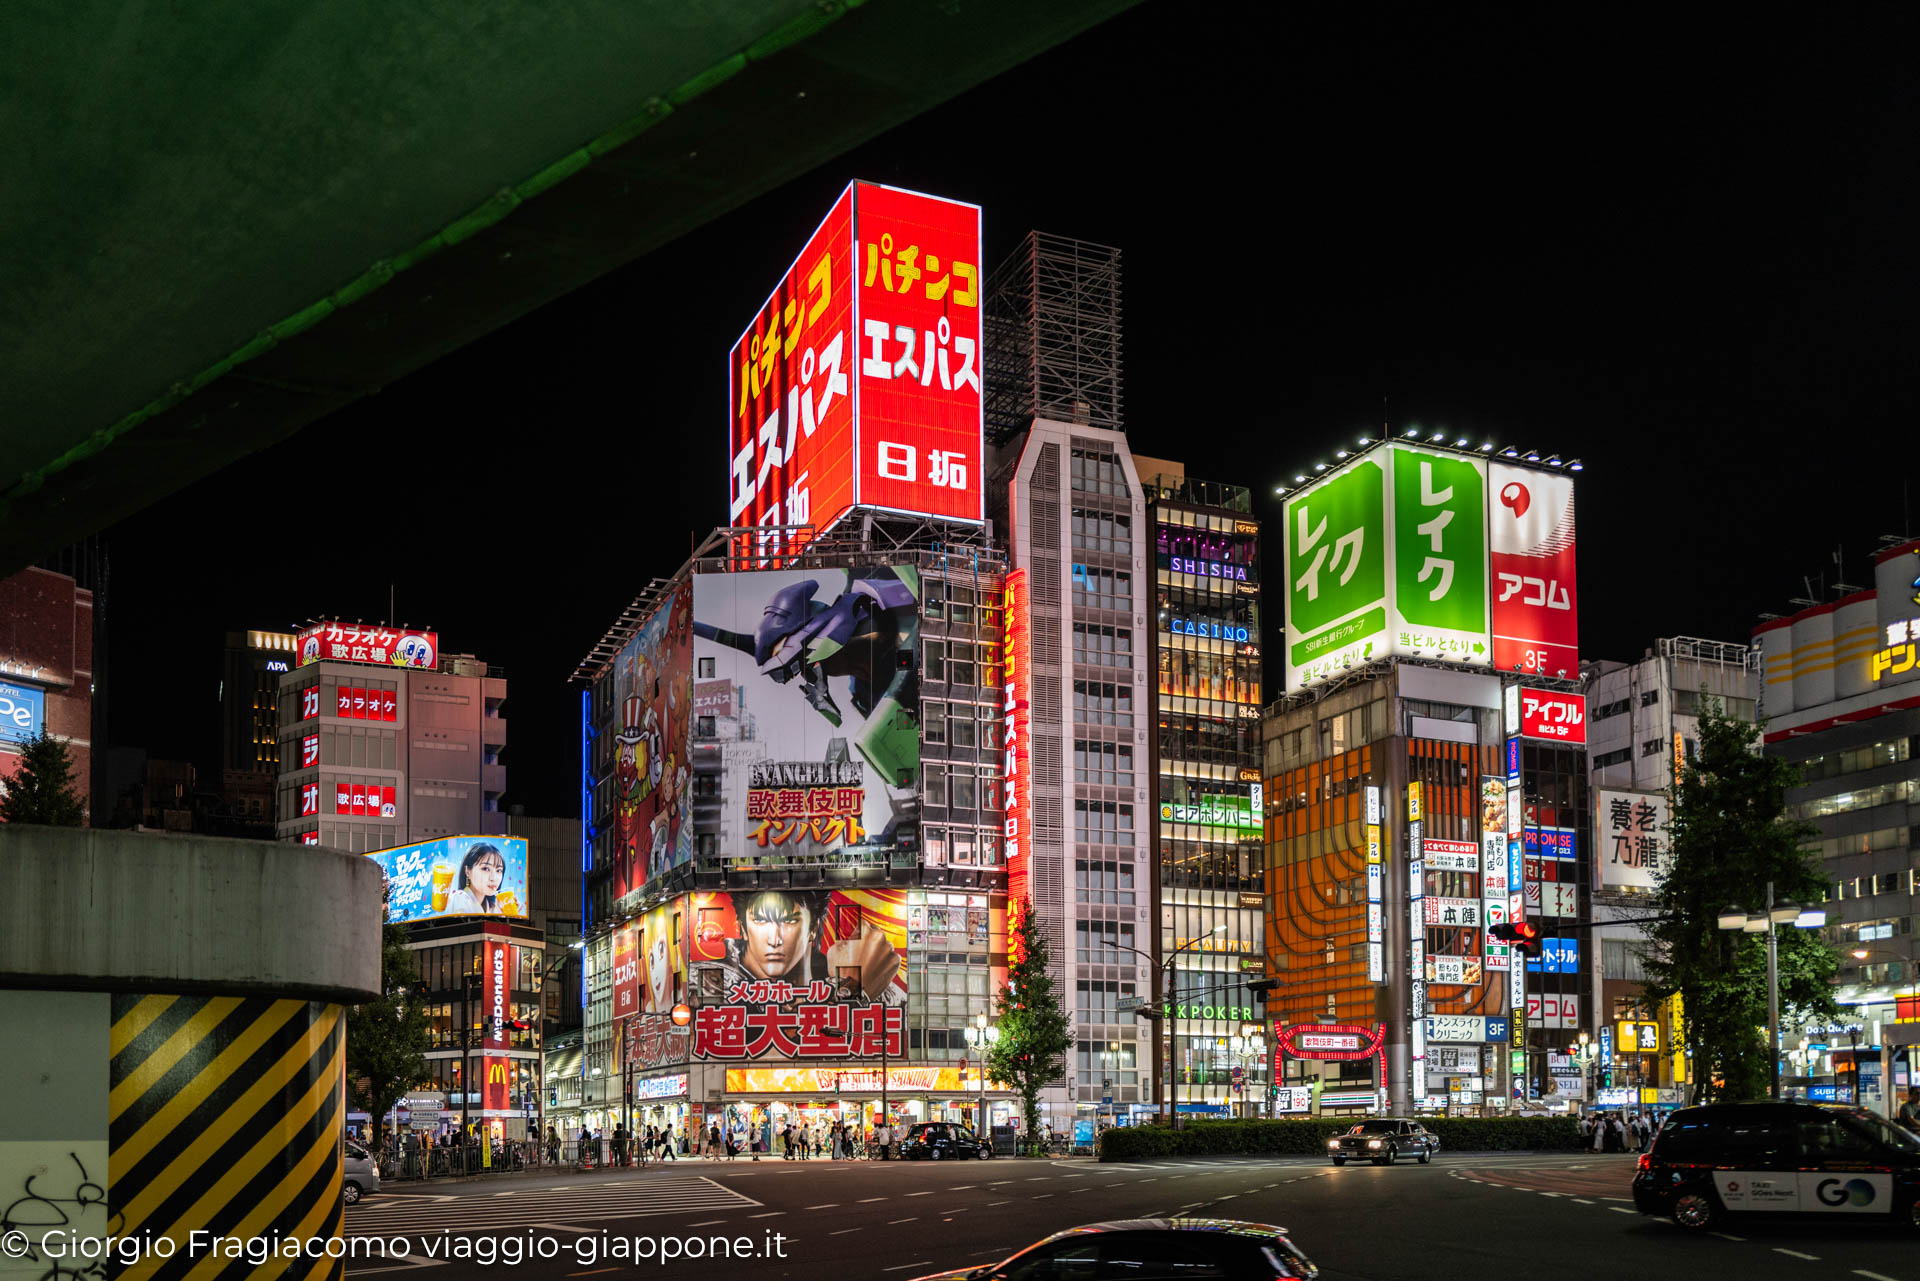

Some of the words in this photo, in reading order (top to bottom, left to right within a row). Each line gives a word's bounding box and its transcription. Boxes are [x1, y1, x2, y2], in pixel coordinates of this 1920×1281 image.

[864, 232, 978, 308] パチンコ
[739, 252, 833, 418] パチンコ
[862, 316, 980, 395] エスパス
[731, 329, 848, 522] エスパス
[877, 441, 967, 490] 日拓
[1417, 460, 1456, 602] レイク
[1296, 506, 1365, 603] レイク
[1171, 557, 1247, 581] SHISHA
[1498, 572, 1572, 611] アコム
[326, 624, 397, 646] カラオケ
[1004, 583, 1016, 678] パチンコ
[1171, 619, 1249, 642] CASINO
[1305, 618, 1365, 653] SBI新生銀行グループ
[331, 643, 387, 662] 歌広場
[1399, 632, 1470, 654] 当ビルとなり
[266, 661, 288, 672] APA
[1302, 647, 1361, 683] 当ビルとなり
[1525, 650, 1548, 669] 3F
[338, 696, 396, 712] カラオケ
[1523, 697, 1583, 725] アイフル
[1556, 726, 1569, 736] 5F
[1004, 682, 1017, 811] エスパス
[750, 761, 865, 787] EVANGELION
[337, 793, 380, 808] 歌広場
[747, 788, 866, 818] 歌舞伎町
[1252, 785, 1261, 809] ダーツ
[1610, 797, 1658, 834] 養老
[746, 815, 867, 847] インパクト
[1525, 831, 1571, 848] PROMISE
[1455, 856, 1477, 869] 本陣
[1486, 840, 1495, 871] 専門店
[1495, 836, 1504, 867] 粉もの
[1485, 876, 1506, 889] 本陣
[1443, 906, 1476, 925] 本陣
[1176, 938, 1251, 953] BEAUTY
[615, 957, 637, 987] エスパス
[1488, 956, 1508, 966] ATM
[728, 979, 832, 1004] メガホール
[1527, 1000, 1577, 1017] アコム
[693, 1002, 903, 1059] 超大型店
[1436, 1016, 1481, 1028] メンズライフ
[1488, 1023, 1505, 1036] 3F
[1304, 1037, 1357, 1048] 歌舞伎町一番街
[1436, 1030, 1473, 1040] クリニック
[1551, 1055, 1568, 1064] BUY
[1559, 1080, 1580, 1090] SELL
[1293, 1097, 1306, 1107] 190
[1816, 1178, 1876, 1207] GO
